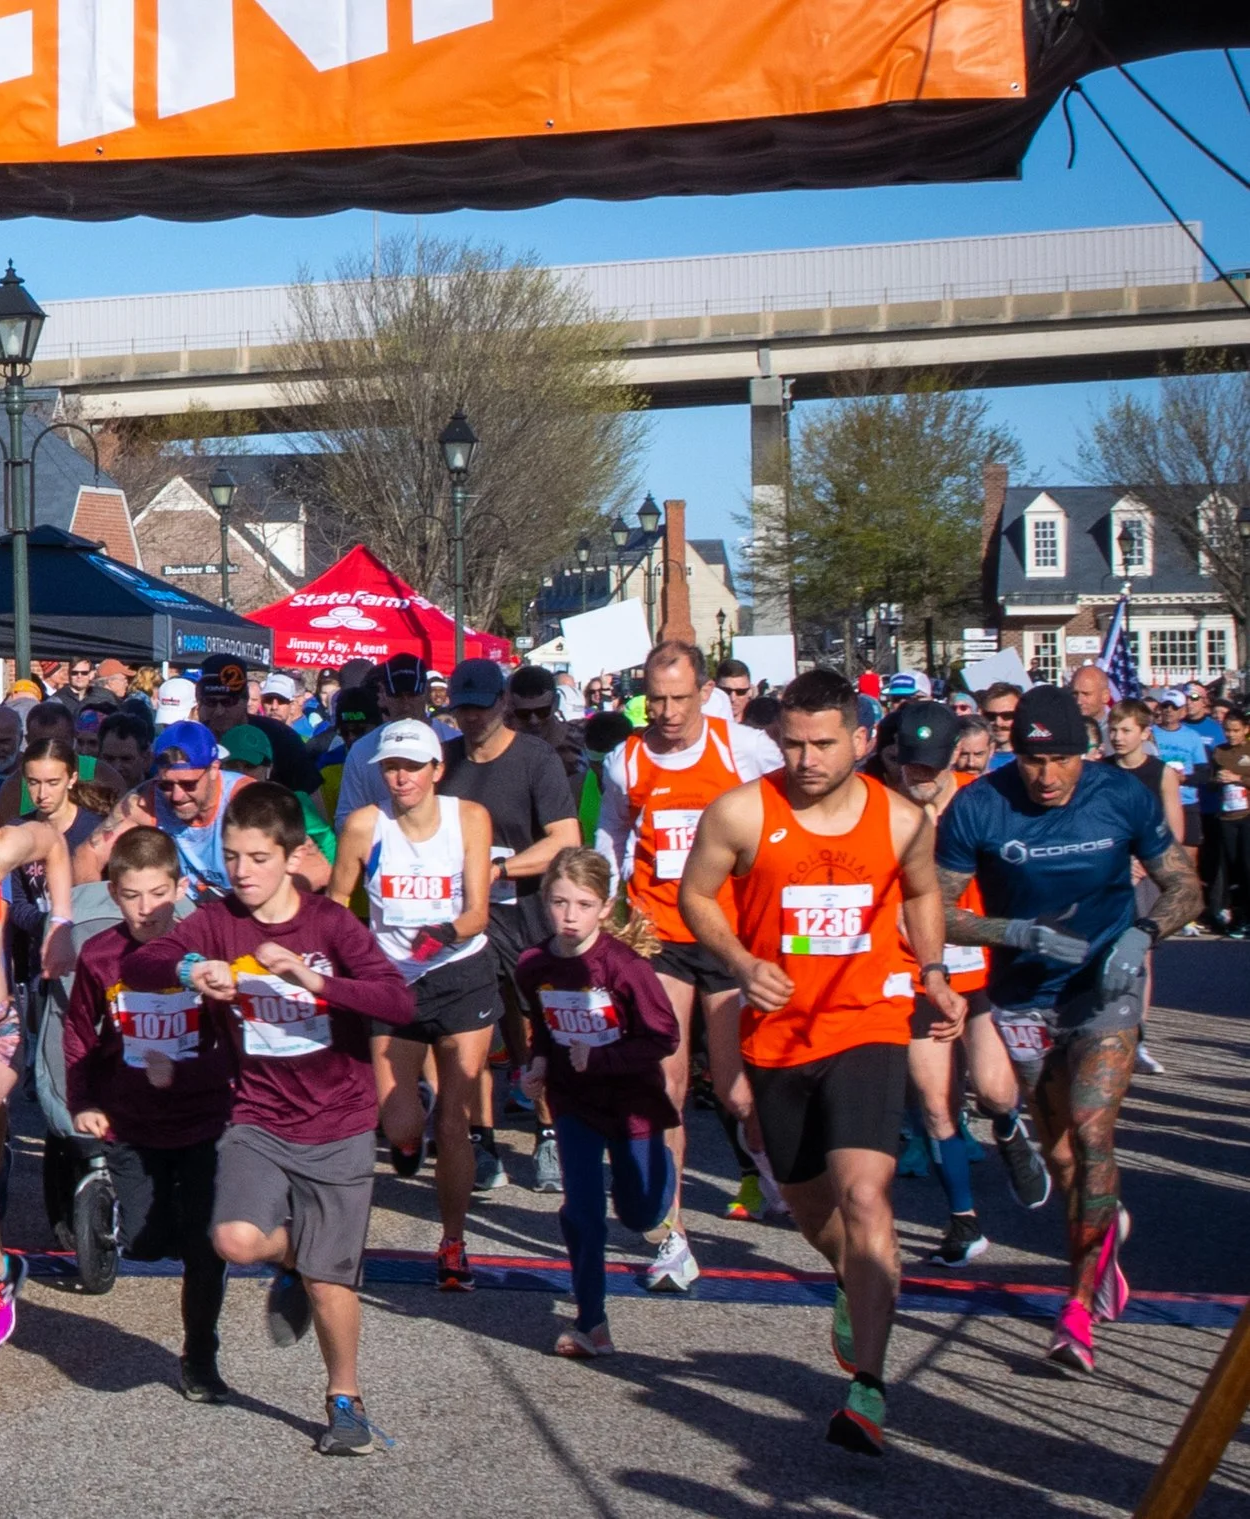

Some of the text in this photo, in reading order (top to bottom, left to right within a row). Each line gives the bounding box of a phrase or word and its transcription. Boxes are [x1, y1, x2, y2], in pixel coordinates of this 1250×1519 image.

[164, 565, 203, 575] Buckner
[205, 564, 219, 574] St.
[286, 637, 388, 655] Jimmy Fay, Agent
[1029, 838, 1114, 858] COROS
[787, 849, 874, 885] COLONIAL
[388, 877, 443, 900] 1208
[793, 908, 862, 936] 1236
[247, 992, 316, 1023] 1069
[131, 1012, 187, 1039] 1070
